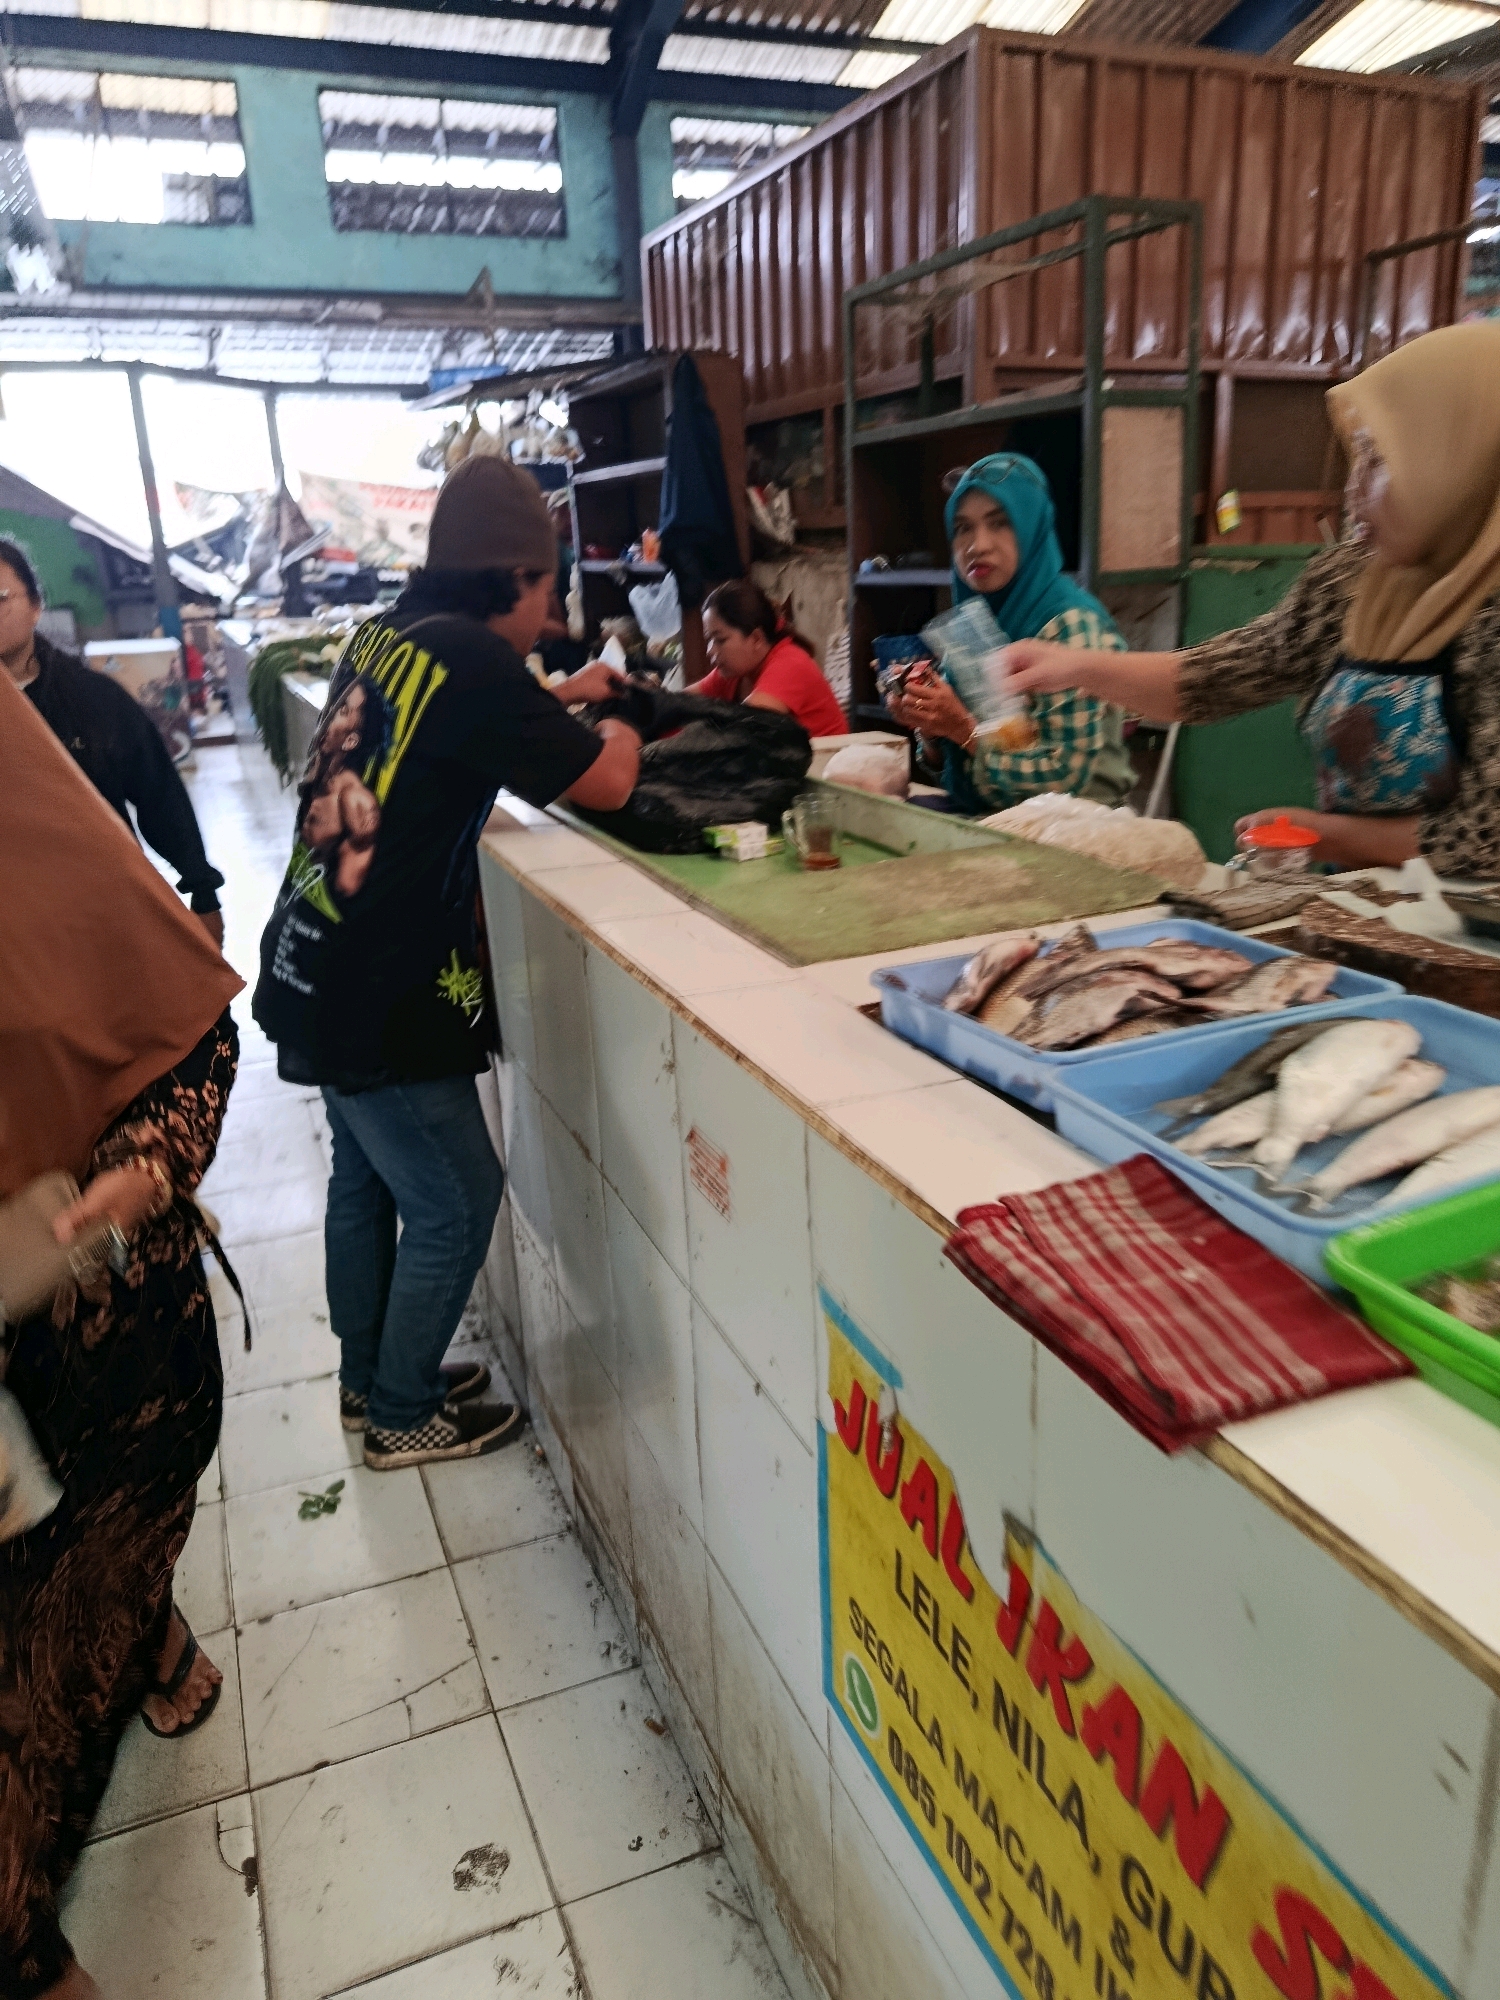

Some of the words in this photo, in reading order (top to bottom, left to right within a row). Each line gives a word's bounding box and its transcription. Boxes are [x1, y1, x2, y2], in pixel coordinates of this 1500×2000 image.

[833, 1377, 975, 1605] JUAL
[995, 1557, 1235, 1895] IKAN
[849, 1596, 946, 1767] SEGALA
[954, 1745, 1082, 1965] MACAM
[895, 1547, 979, 1712] LELE,
[993, 1676, 1101, 1875] NILA,
[887, 1725, 936, 1829] 085
[941, 1810, 992, 1920] 102
[1109, 1913, 1135, 1983] &
